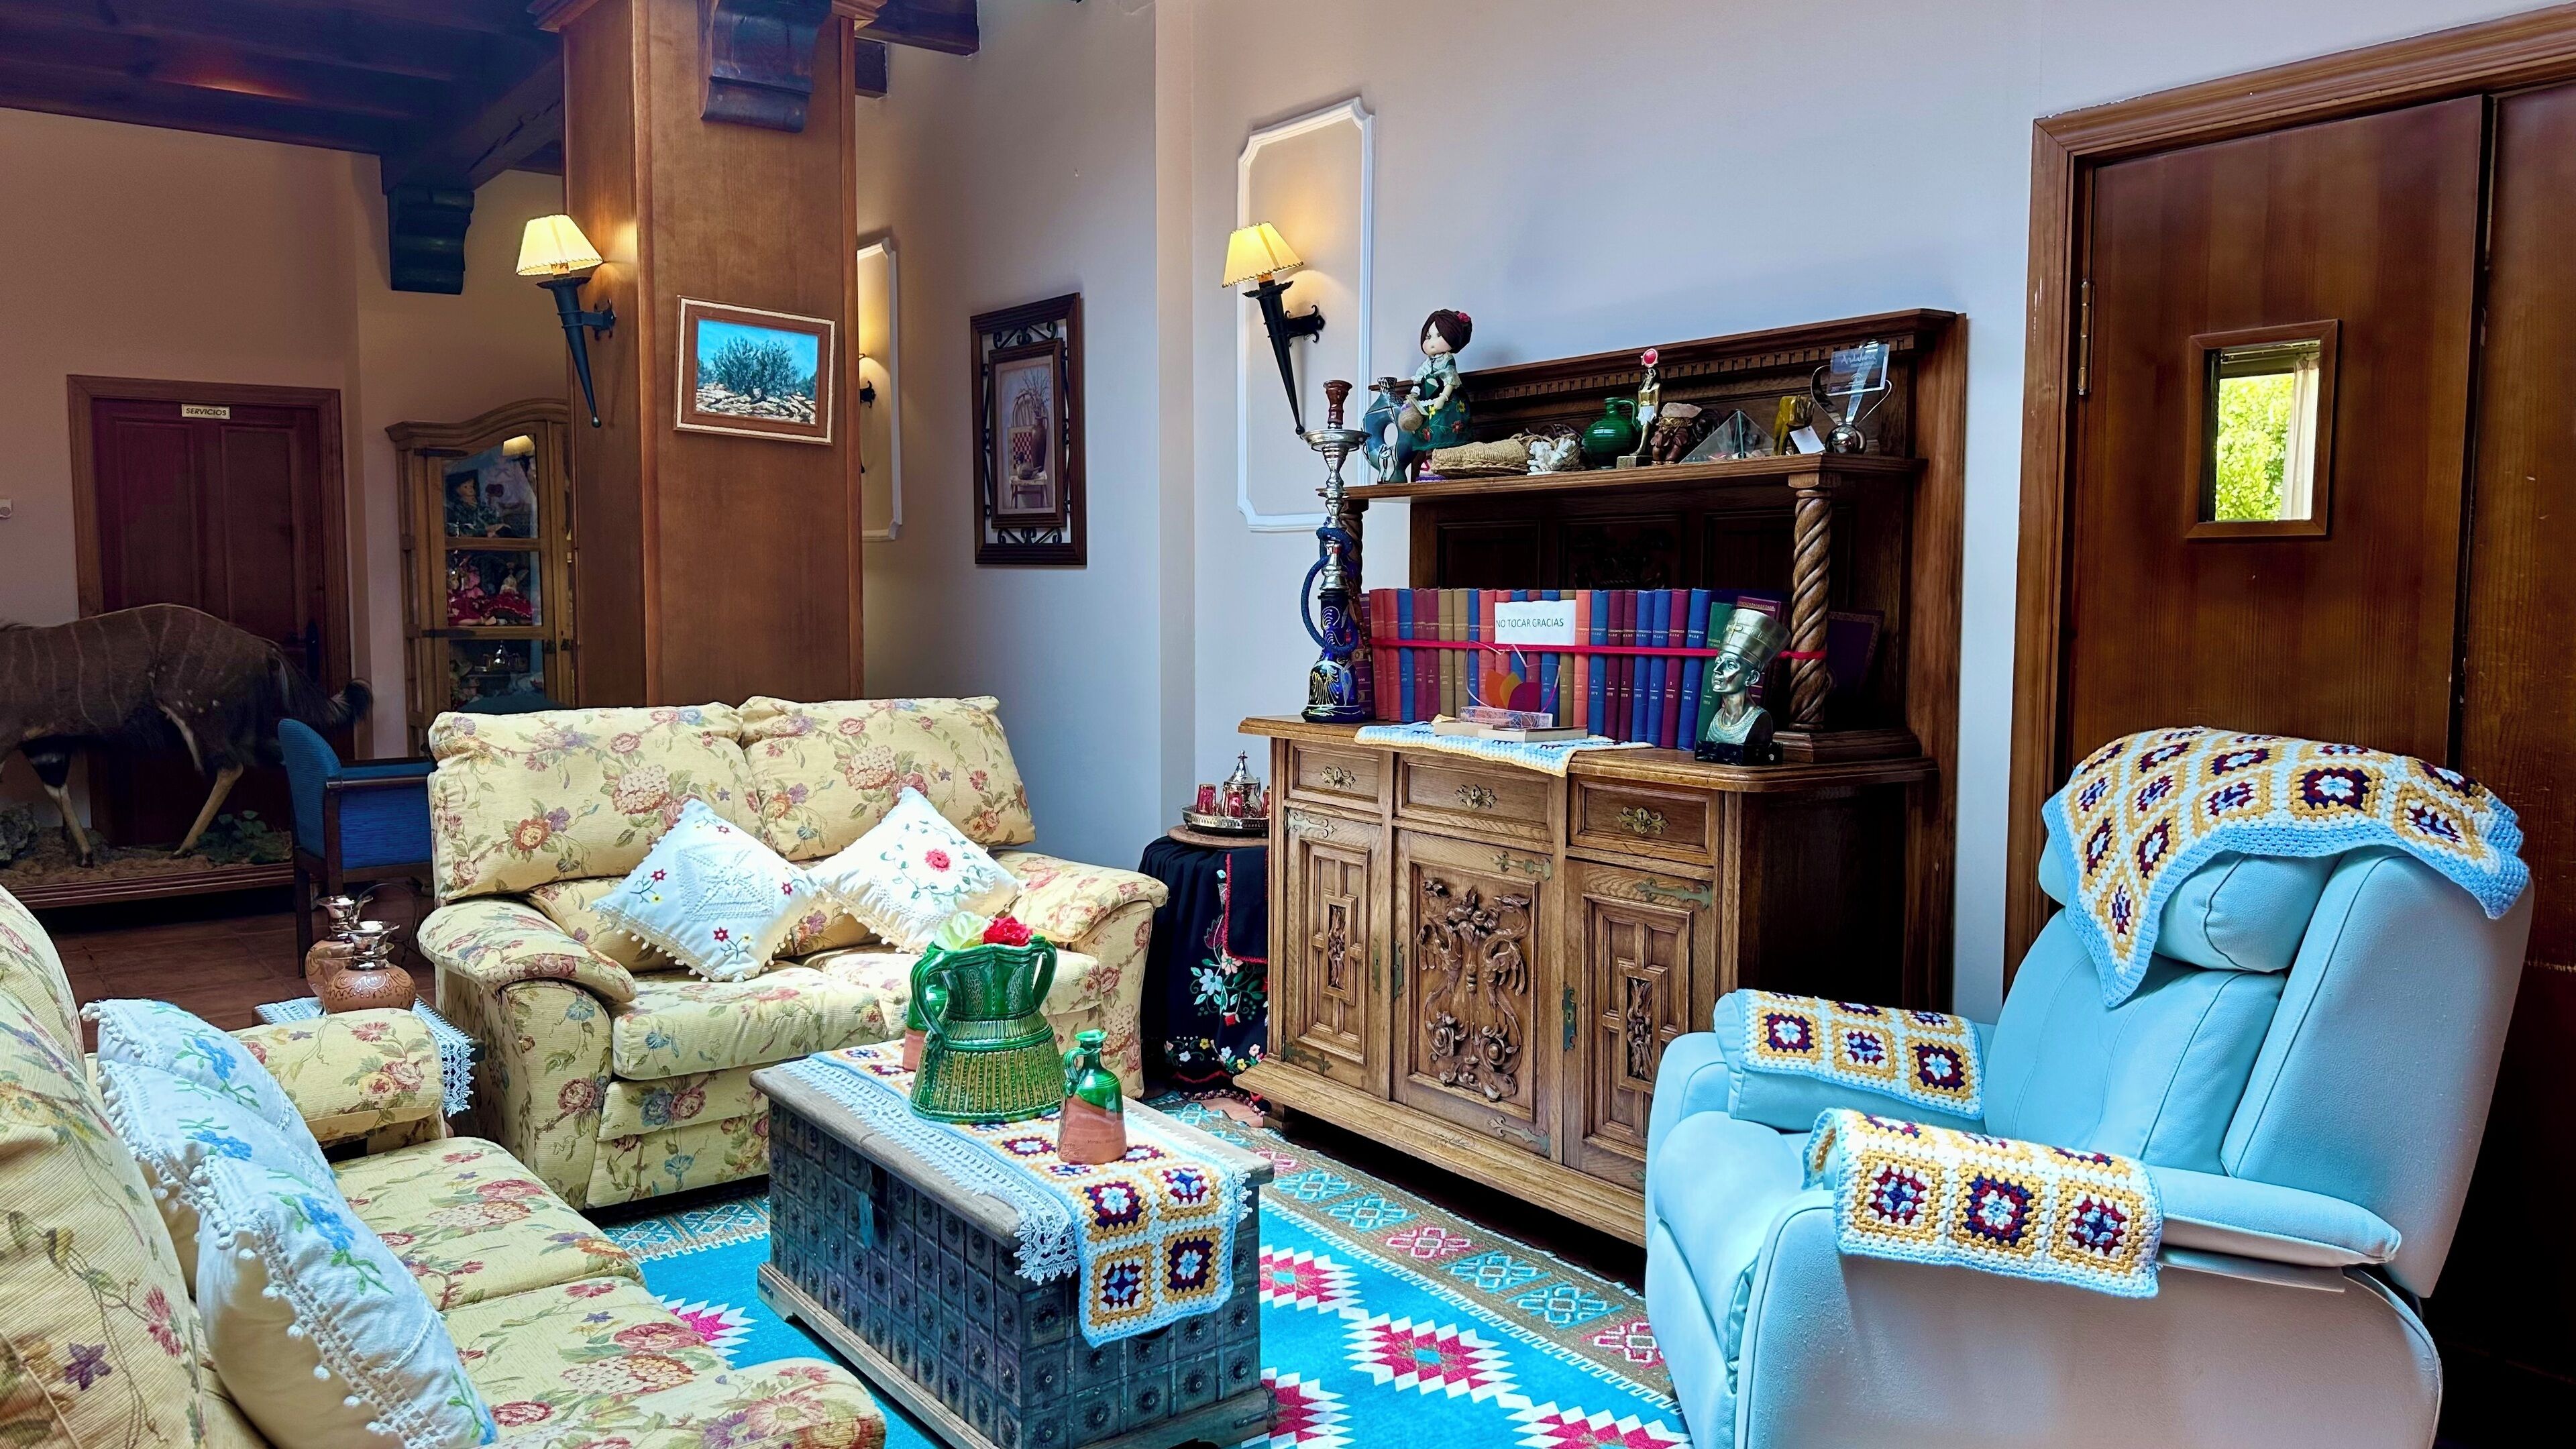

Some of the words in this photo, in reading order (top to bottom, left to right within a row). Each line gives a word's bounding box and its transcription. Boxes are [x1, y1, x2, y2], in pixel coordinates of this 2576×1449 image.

[186, 407, 227, 416] SERVICIOS
[1496, 619, 1506, 628] NO
[1508, 619, 1531, 628] TOCAR
[1532, 618, 1564, 627] GRACIAS
